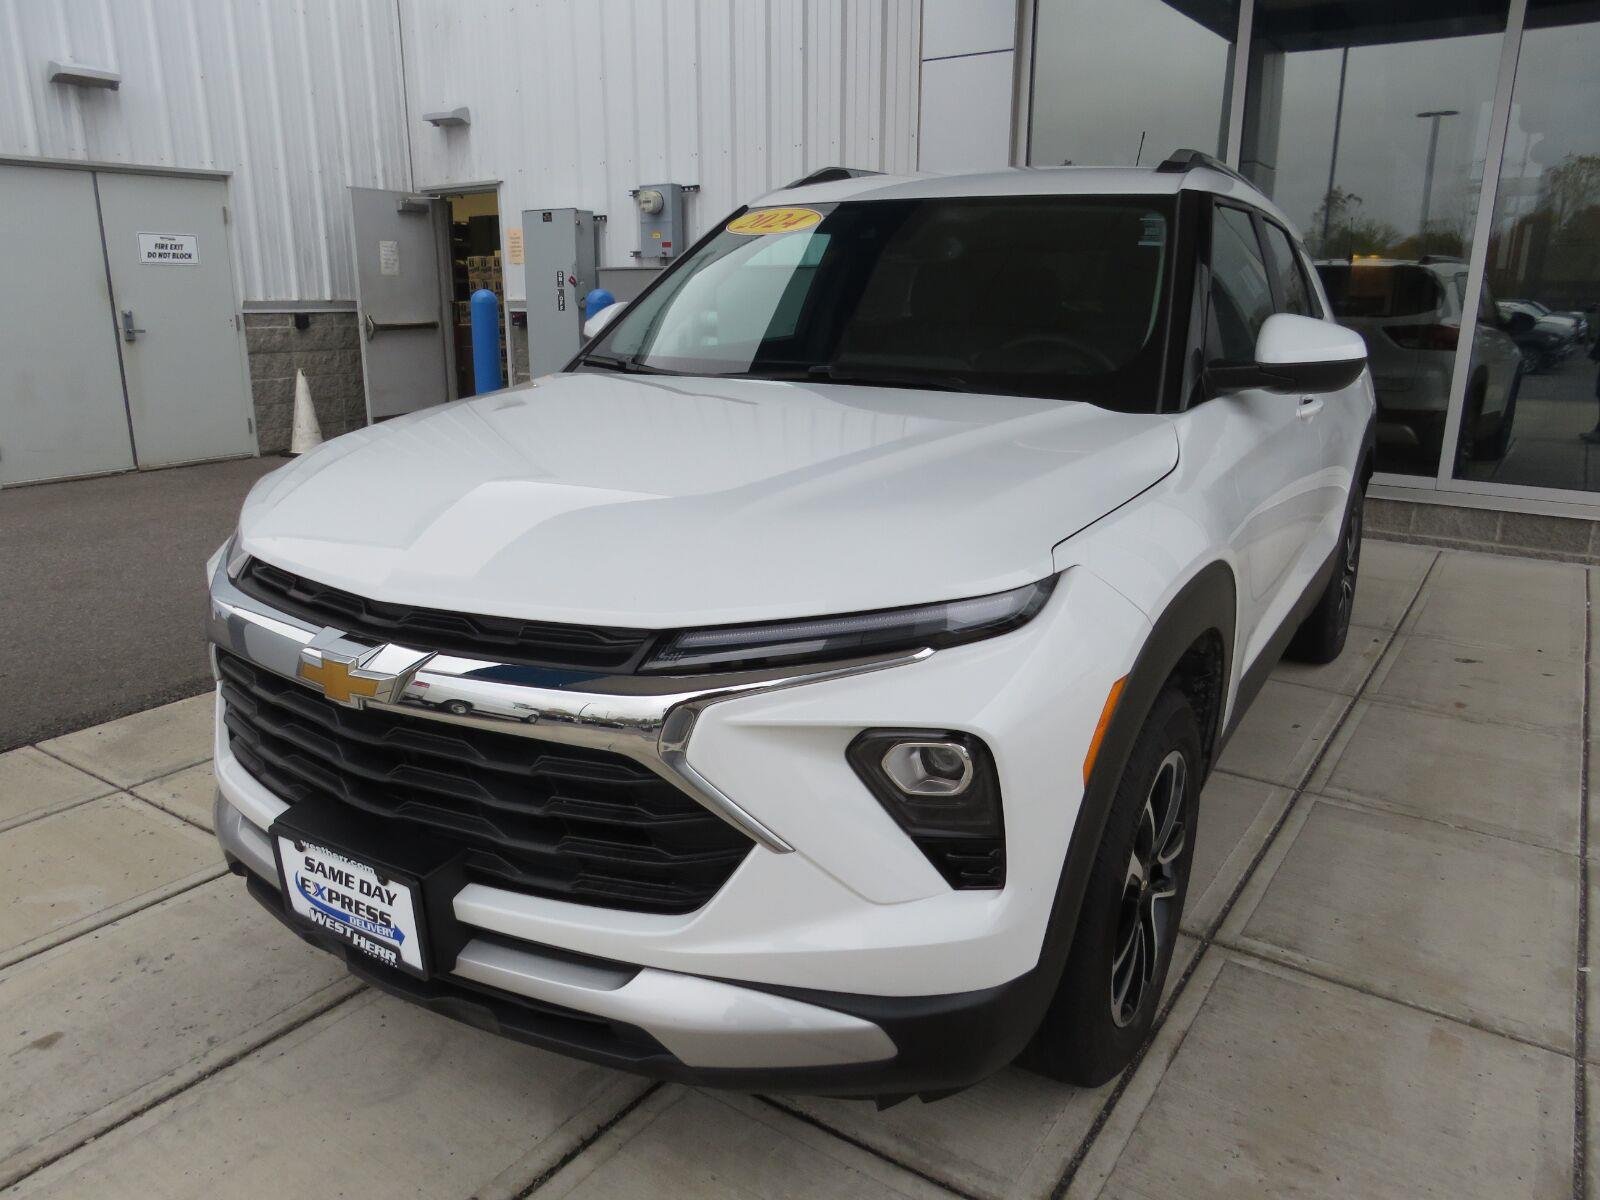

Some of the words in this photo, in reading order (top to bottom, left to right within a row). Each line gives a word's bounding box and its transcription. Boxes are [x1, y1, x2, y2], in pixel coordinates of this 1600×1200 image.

[734, 213, 813, 229] 2024
[154, 243, 169, 251] FIRE
[170, 243, 184, 251] EXIT
[158, 252, 171, 260] NOT
[304, 856, 359, 890] SAME
[359, 879, 397, 907] DAY
[300, 876, 393, 928] EXPRESS
[349, 916, 396, 938] DELIVERY
